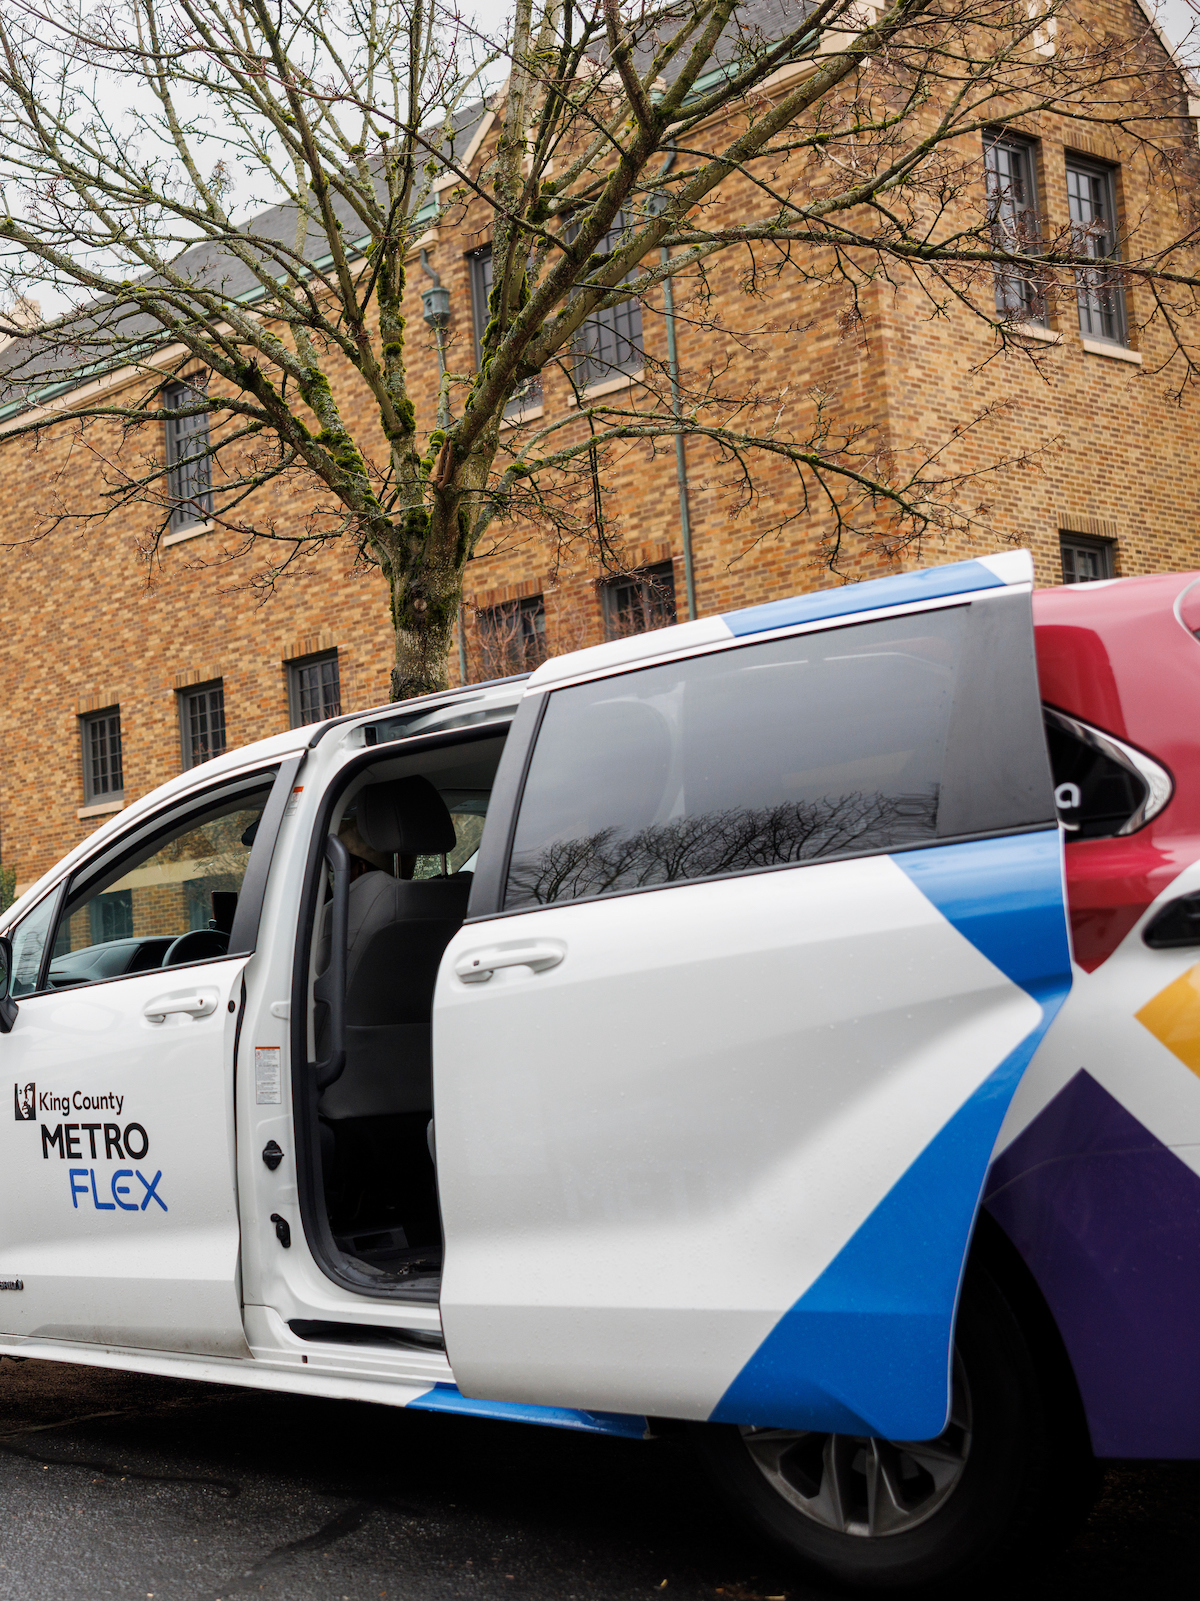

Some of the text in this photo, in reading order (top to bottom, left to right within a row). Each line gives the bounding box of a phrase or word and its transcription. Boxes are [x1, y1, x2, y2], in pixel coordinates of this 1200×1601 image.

[39, 1090, 124, 1116] King County
[40, 1122, 149, 1160] METRO
[69, 1168, 168, 1212] FLEX
